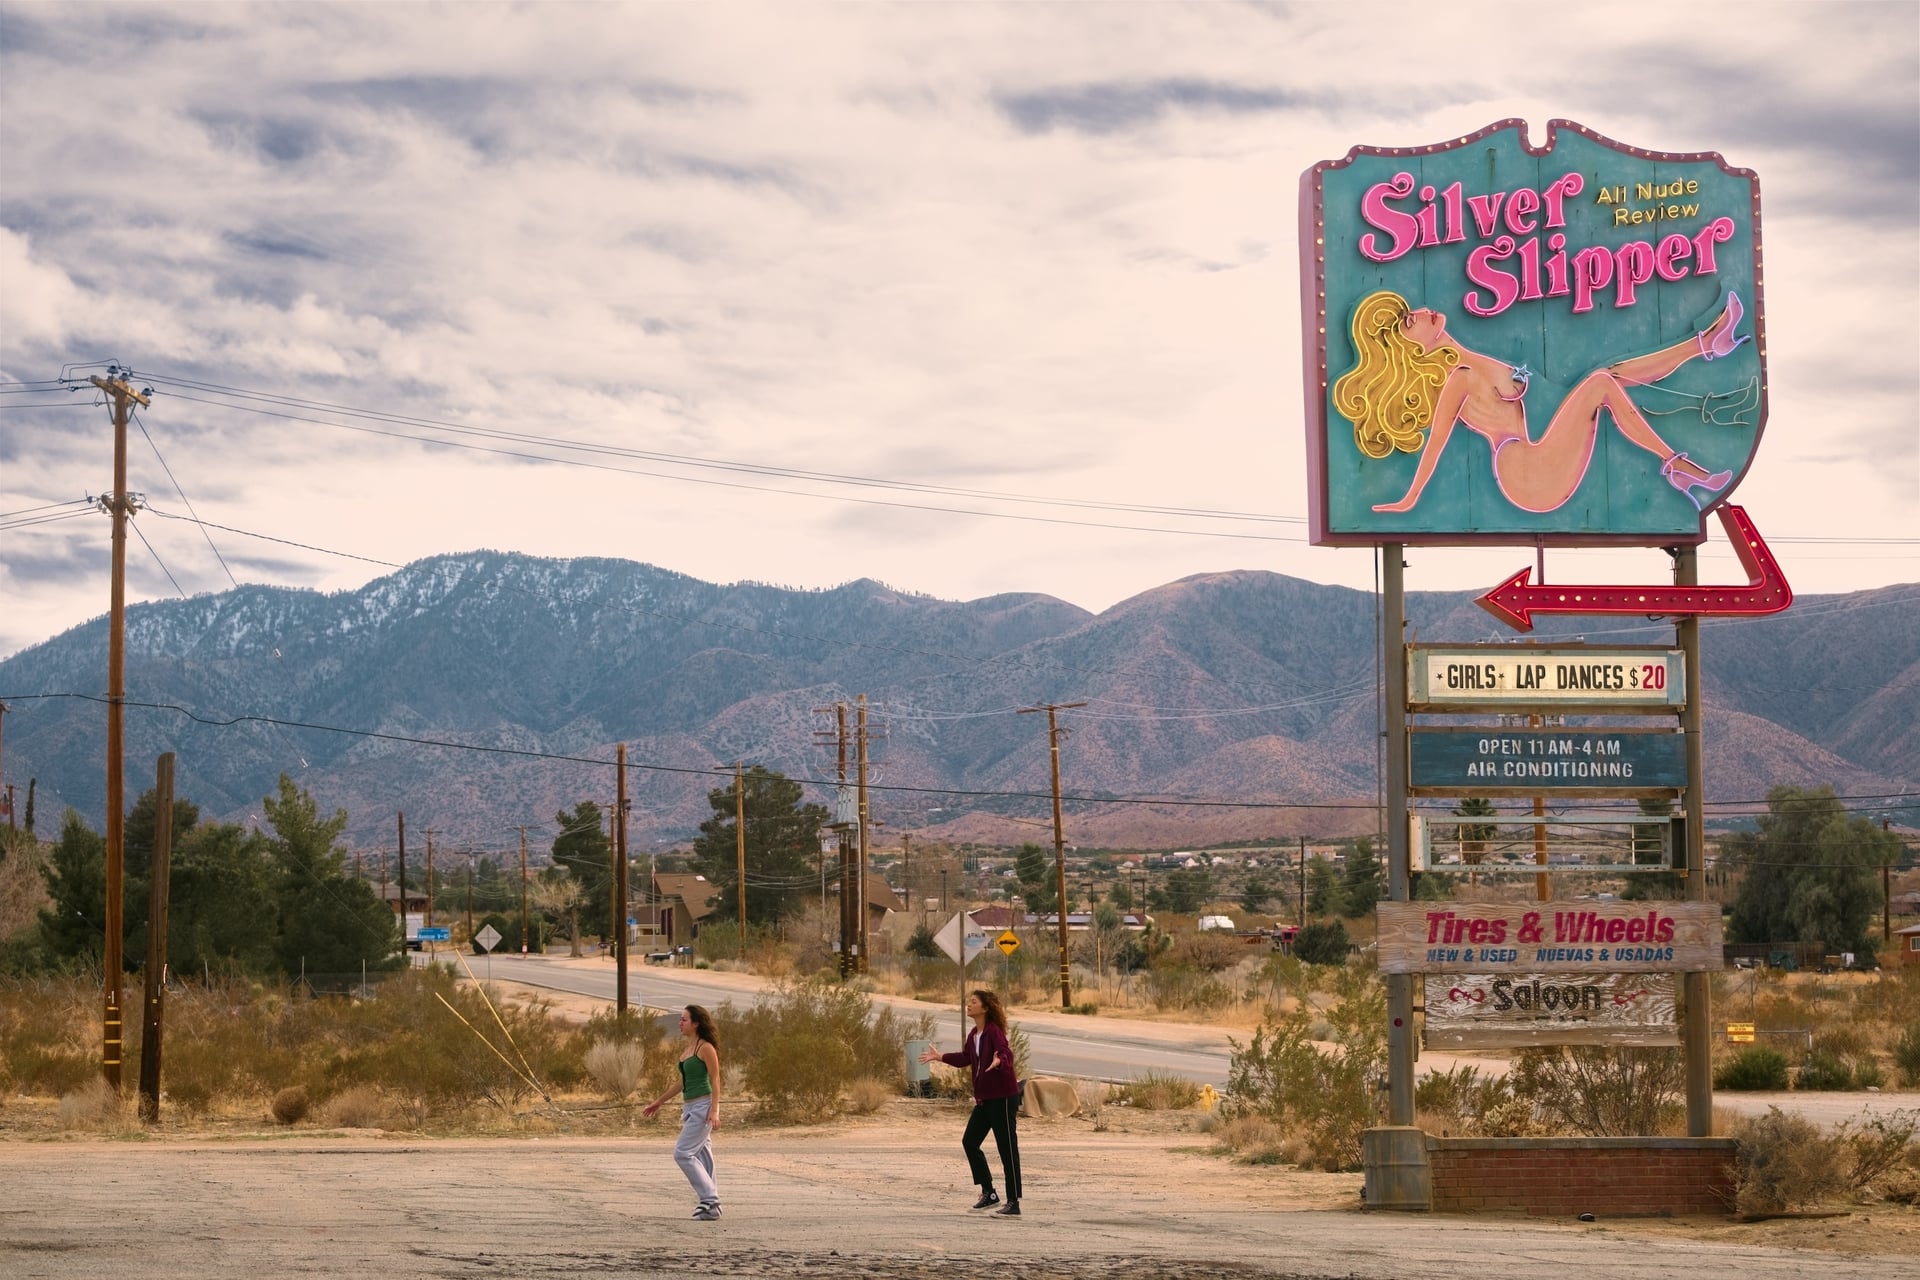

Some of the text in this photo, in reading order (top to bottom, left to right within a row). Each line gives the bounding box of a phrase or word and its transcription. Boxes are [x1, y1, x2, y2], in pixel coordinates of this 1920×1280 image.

[1595, 177, 1699, 206] All Nude
[1358, 171, 1585, 263] Silver
[1613, 202, 1700, 227] Review
[1463, 216, 1735, 317] Slipper
[1447, 664, 1496, 689] GIRLS
[1516, 664, 1546, 689] LAP
[1557, 664, 1624, 689] DANCES
[1478, 739, 1522, 755] OPEN
[1467, 761, 1633, 778] AIR CONDITIONING
[1426, 911, 1675, 944] Tires & Wheels
[1427, 947, 1674, 962] NEW & USED NUEVAS & USADAS
[1492, 979, 1602, 1011] Saloon
